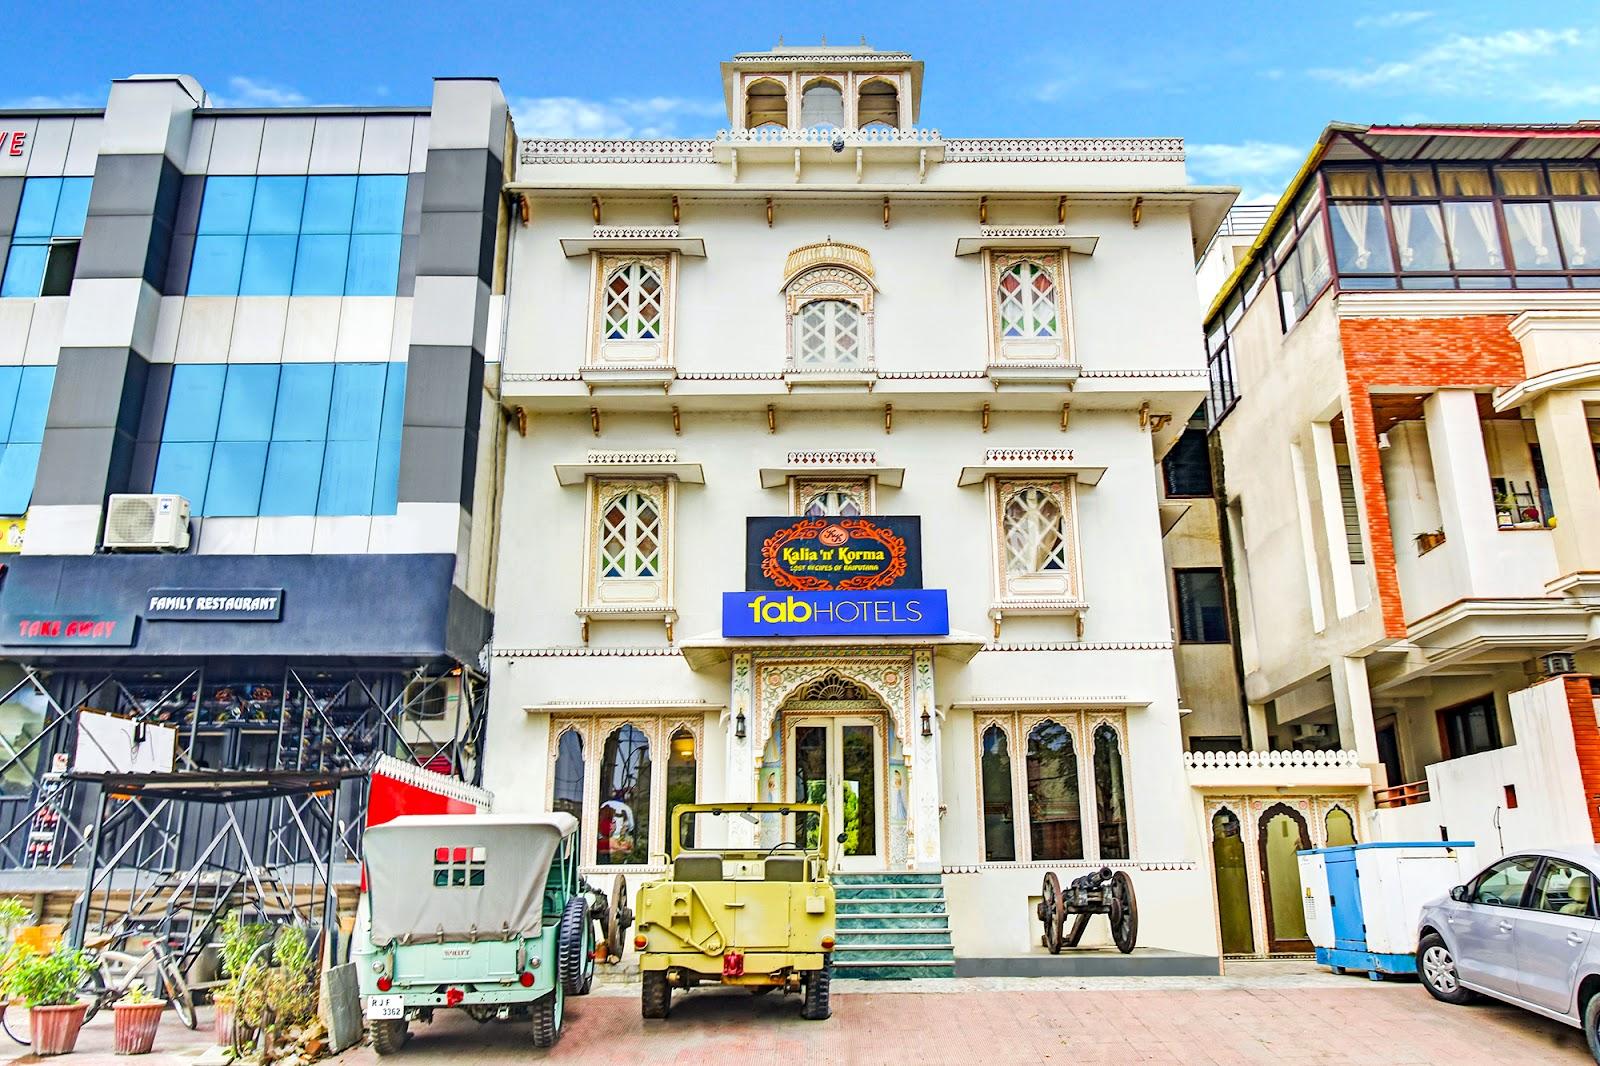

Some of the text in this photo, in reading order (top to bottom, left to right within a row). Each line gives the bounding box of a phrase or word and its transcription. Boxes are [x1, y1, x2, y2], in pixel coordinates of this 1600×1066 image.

[783, 547, 818, 565] Kalia
[838, 547, 885, 565] Korma
[149, 597, 277, 611] FAMILY RESTAURANT
[19, 620, 117, 639] TAKE AWAY
[382, 1007, 401, 1016] 3362
